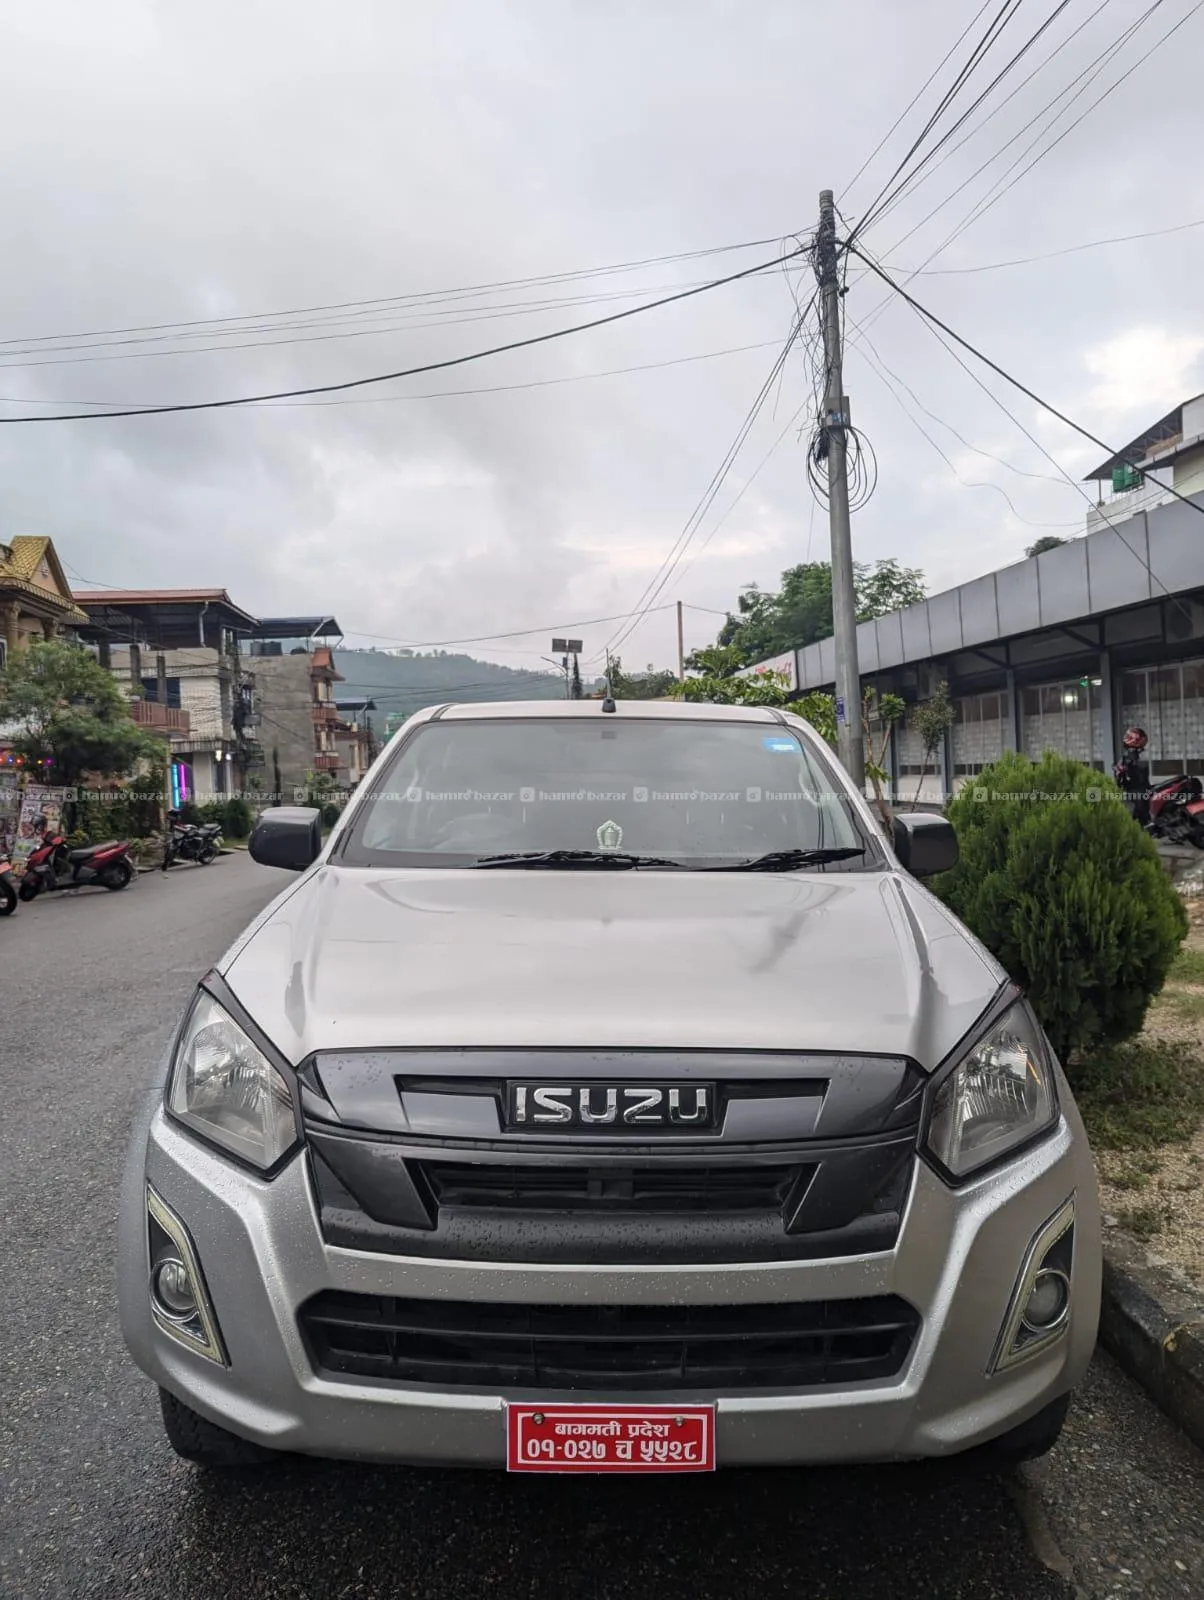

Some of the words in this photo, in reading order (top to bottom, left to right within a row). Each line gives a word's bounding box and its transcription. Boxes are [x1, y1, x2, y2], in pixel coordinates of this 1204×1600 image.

[516, 1087, 707, 1123] ISUZU
[555, 1421, 622, 1436] बागमती
[627, 1420, 670, 1437] प्रदेश
[527, 1438, 606, 1459] ०१-०२७
[615, 1440, 634, 1460] च
[640, 1441, 698, 1463] ५५२८
